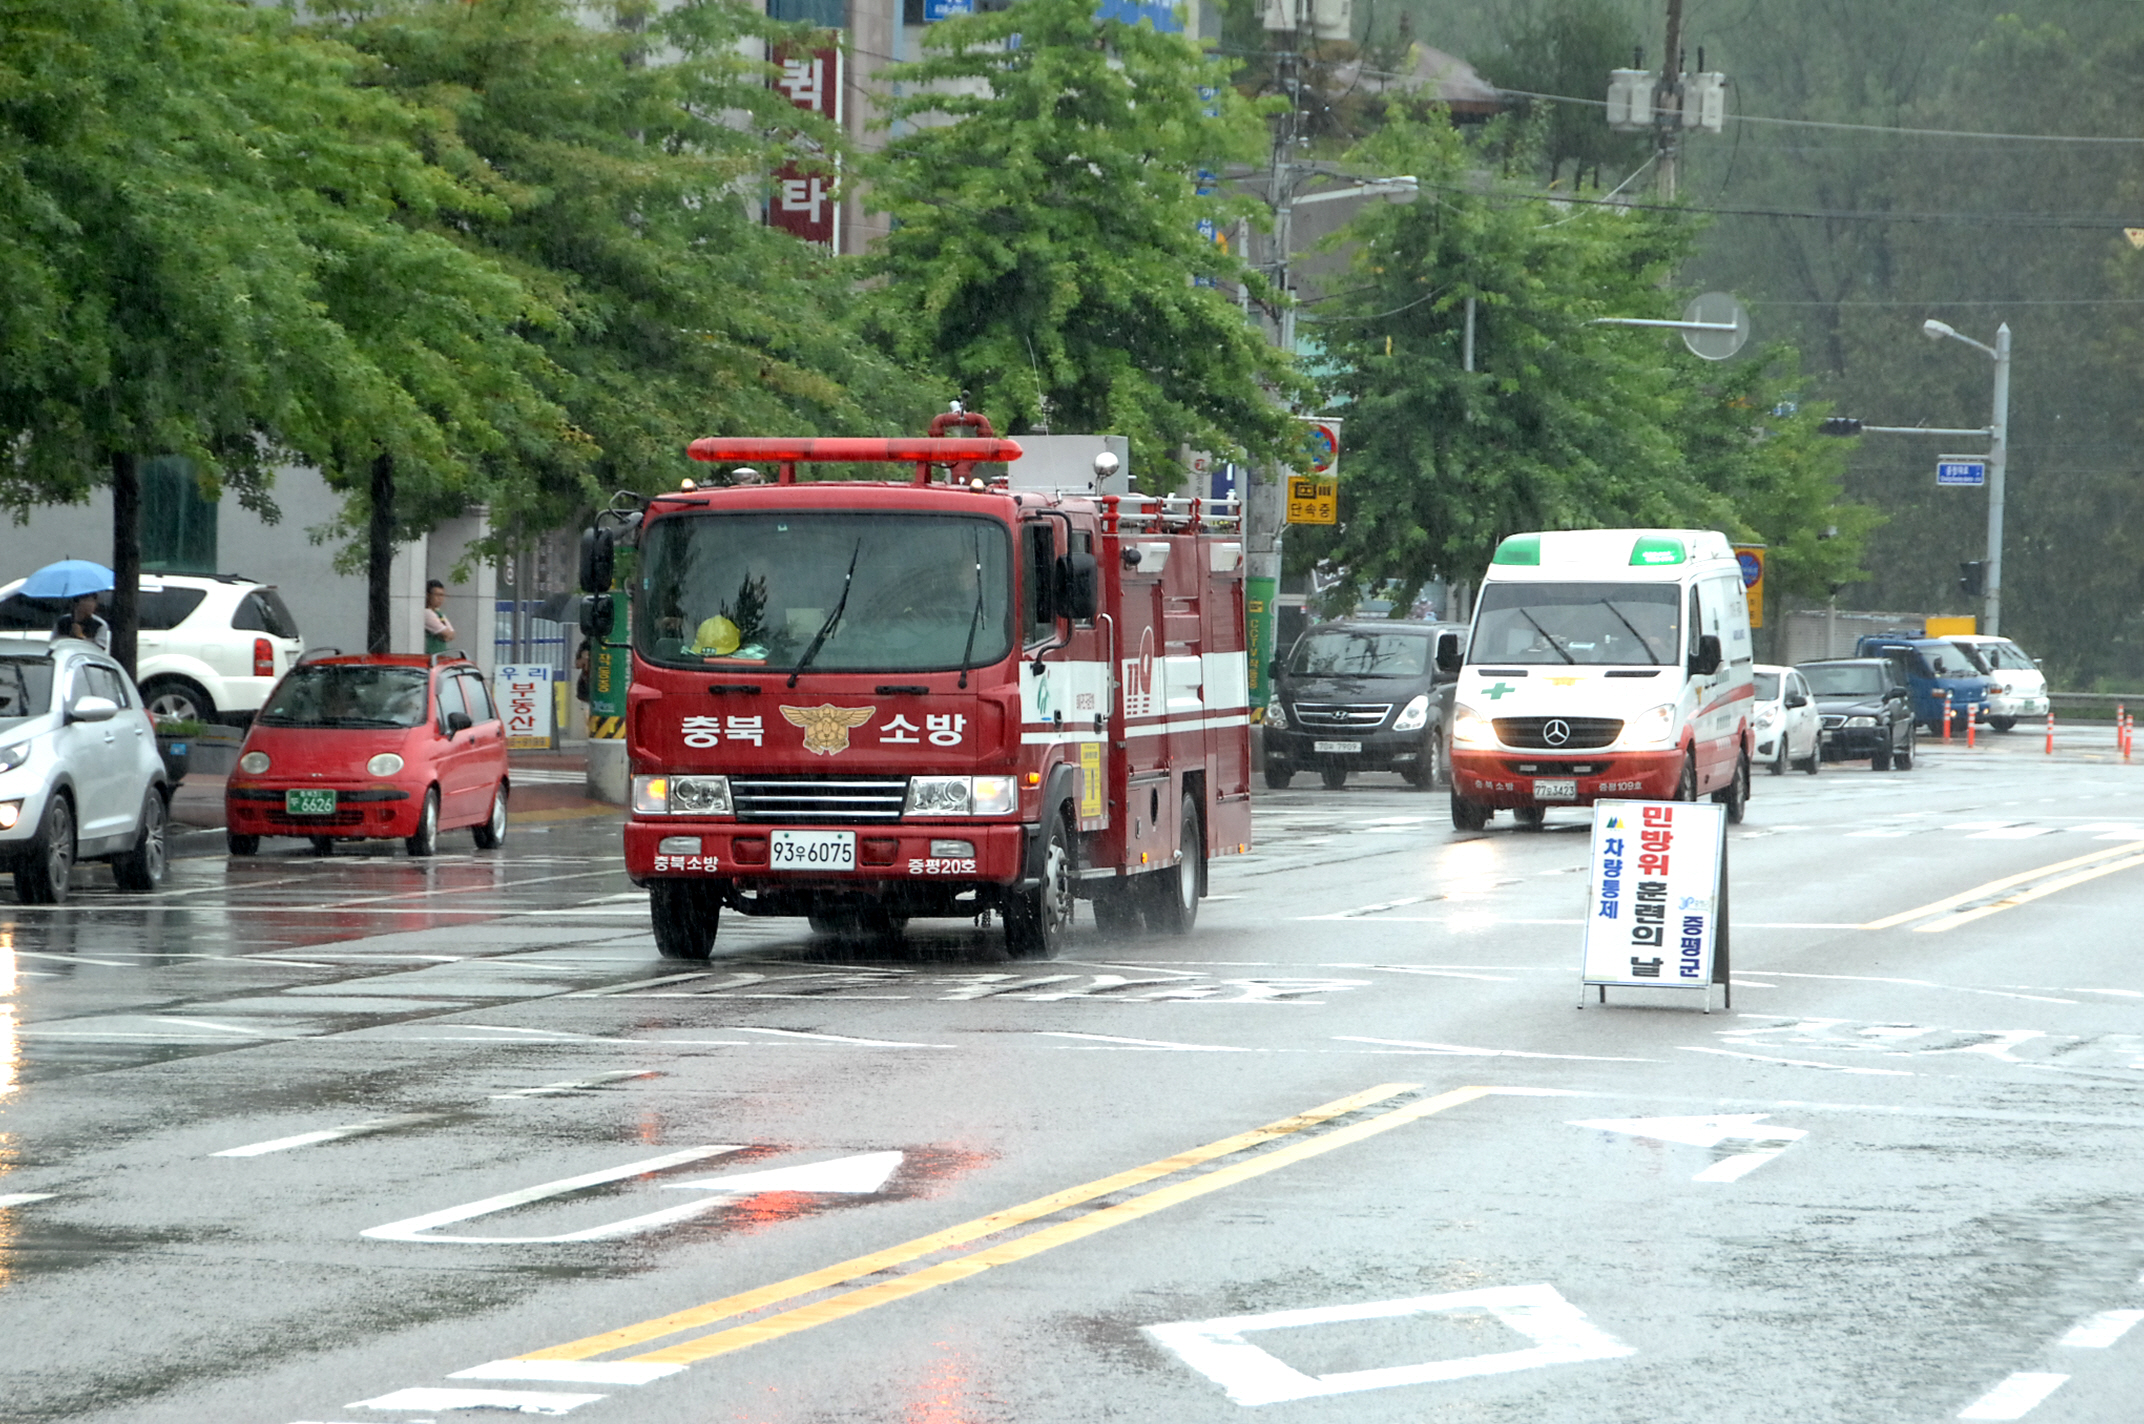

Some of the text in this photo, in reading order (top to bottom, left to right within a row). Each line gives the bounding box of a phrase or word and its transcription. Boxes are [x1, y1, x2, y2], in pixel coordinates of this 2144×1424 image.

[1290, 502, 1331, 518] 단속중
[1249, 618, 1260, 657] CCTV
[499, 666, 548, 681] 우리
[508, 682, 537, 732] 부동산
[681, 713, 967, 748] 충북 소방
[301, 797, 332, 812] 6626
[653, 855, 719, 873] 충북소방
[773, 841, 853, 863] 93우6075
[907, 858, 977, 875] 증평20호
[1598, 837, 1625, 919] 차량통제
[1630, 806, 1674, 978] 민방위 훈련의 날
[1679, 915, 1704, 978] 증평군
